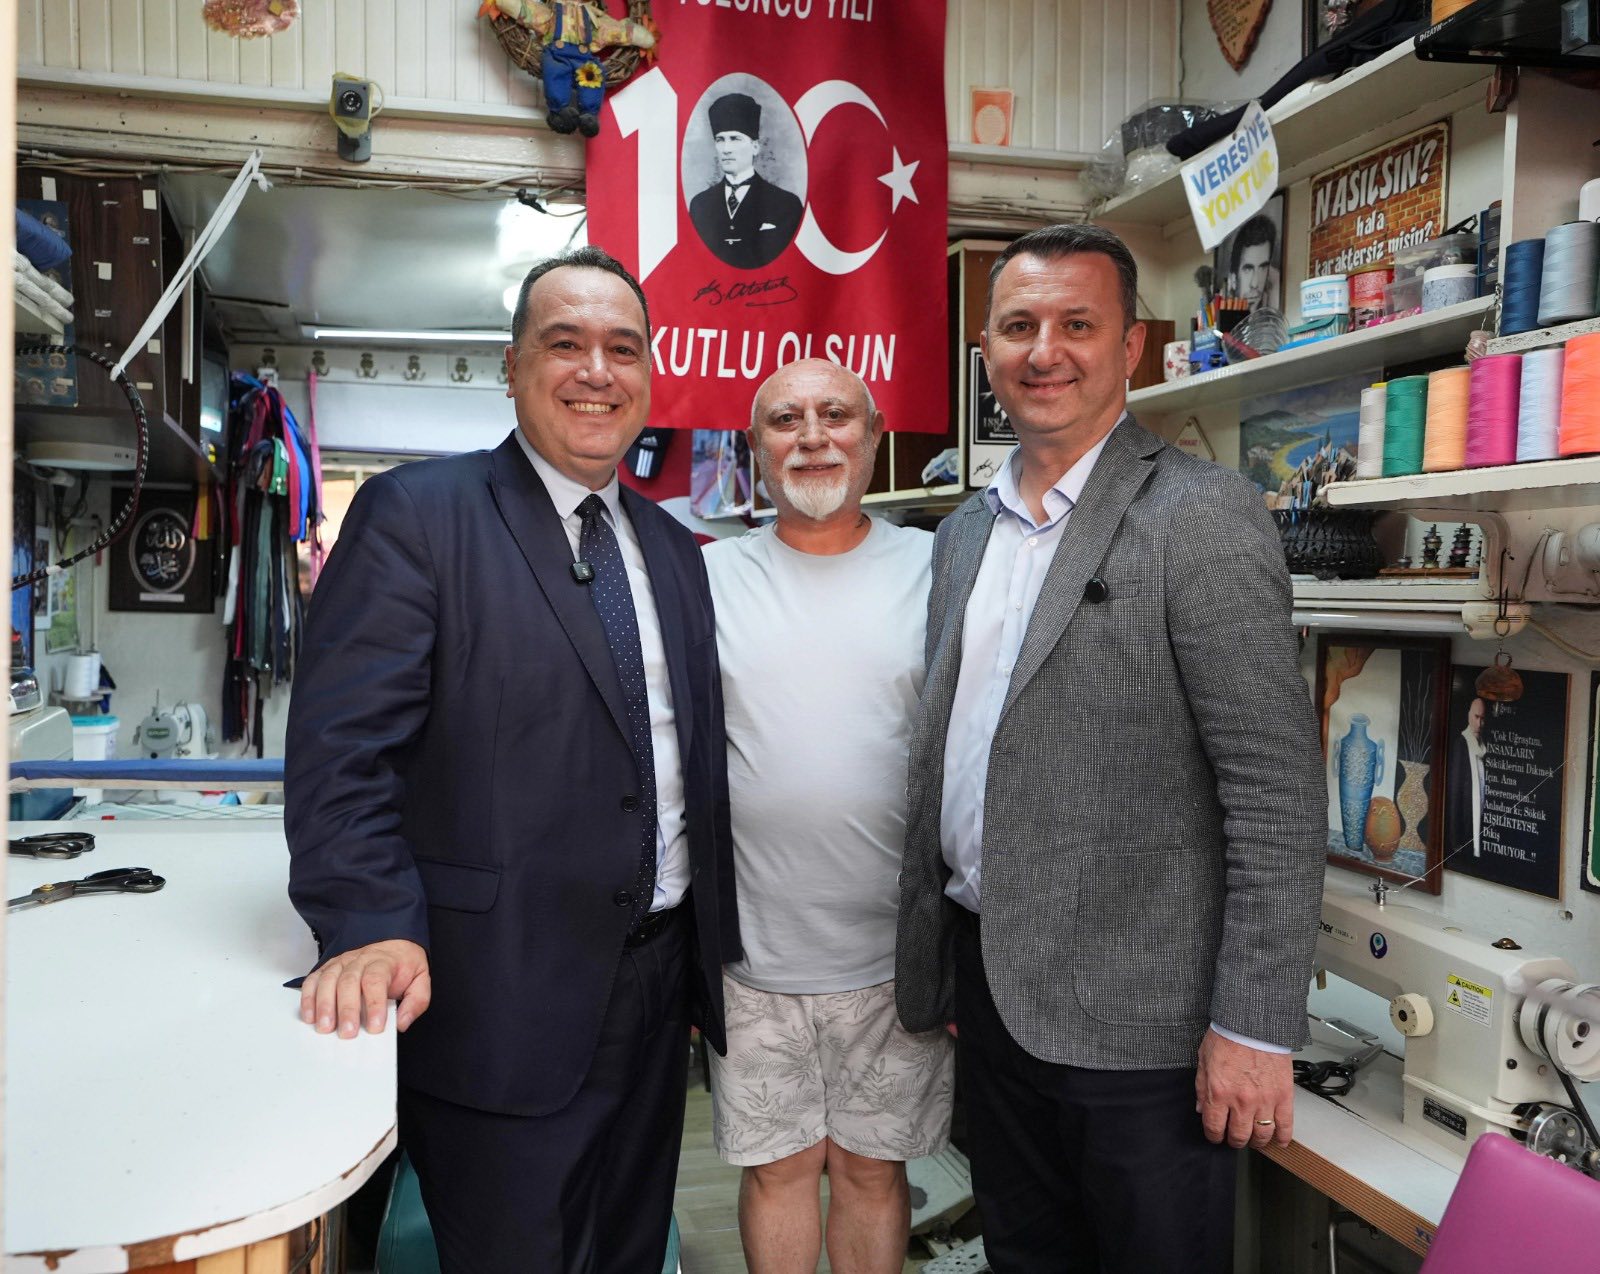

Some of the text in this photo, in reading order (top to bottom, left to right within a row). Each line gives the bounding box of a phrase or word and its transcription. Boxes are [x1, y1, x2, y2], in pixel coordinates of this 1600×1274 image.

[1191, 112, 1269, 197] VERESİYE
[1315, 139, 1438, 225] NASILSIN?
[1356, 210, 1385, 237] hala
[1314, 241, 1384, 277] karaktersiz
[651, 326, 765, 379] KUTLU
[1461, 981, 1484, 995] CAUTION
